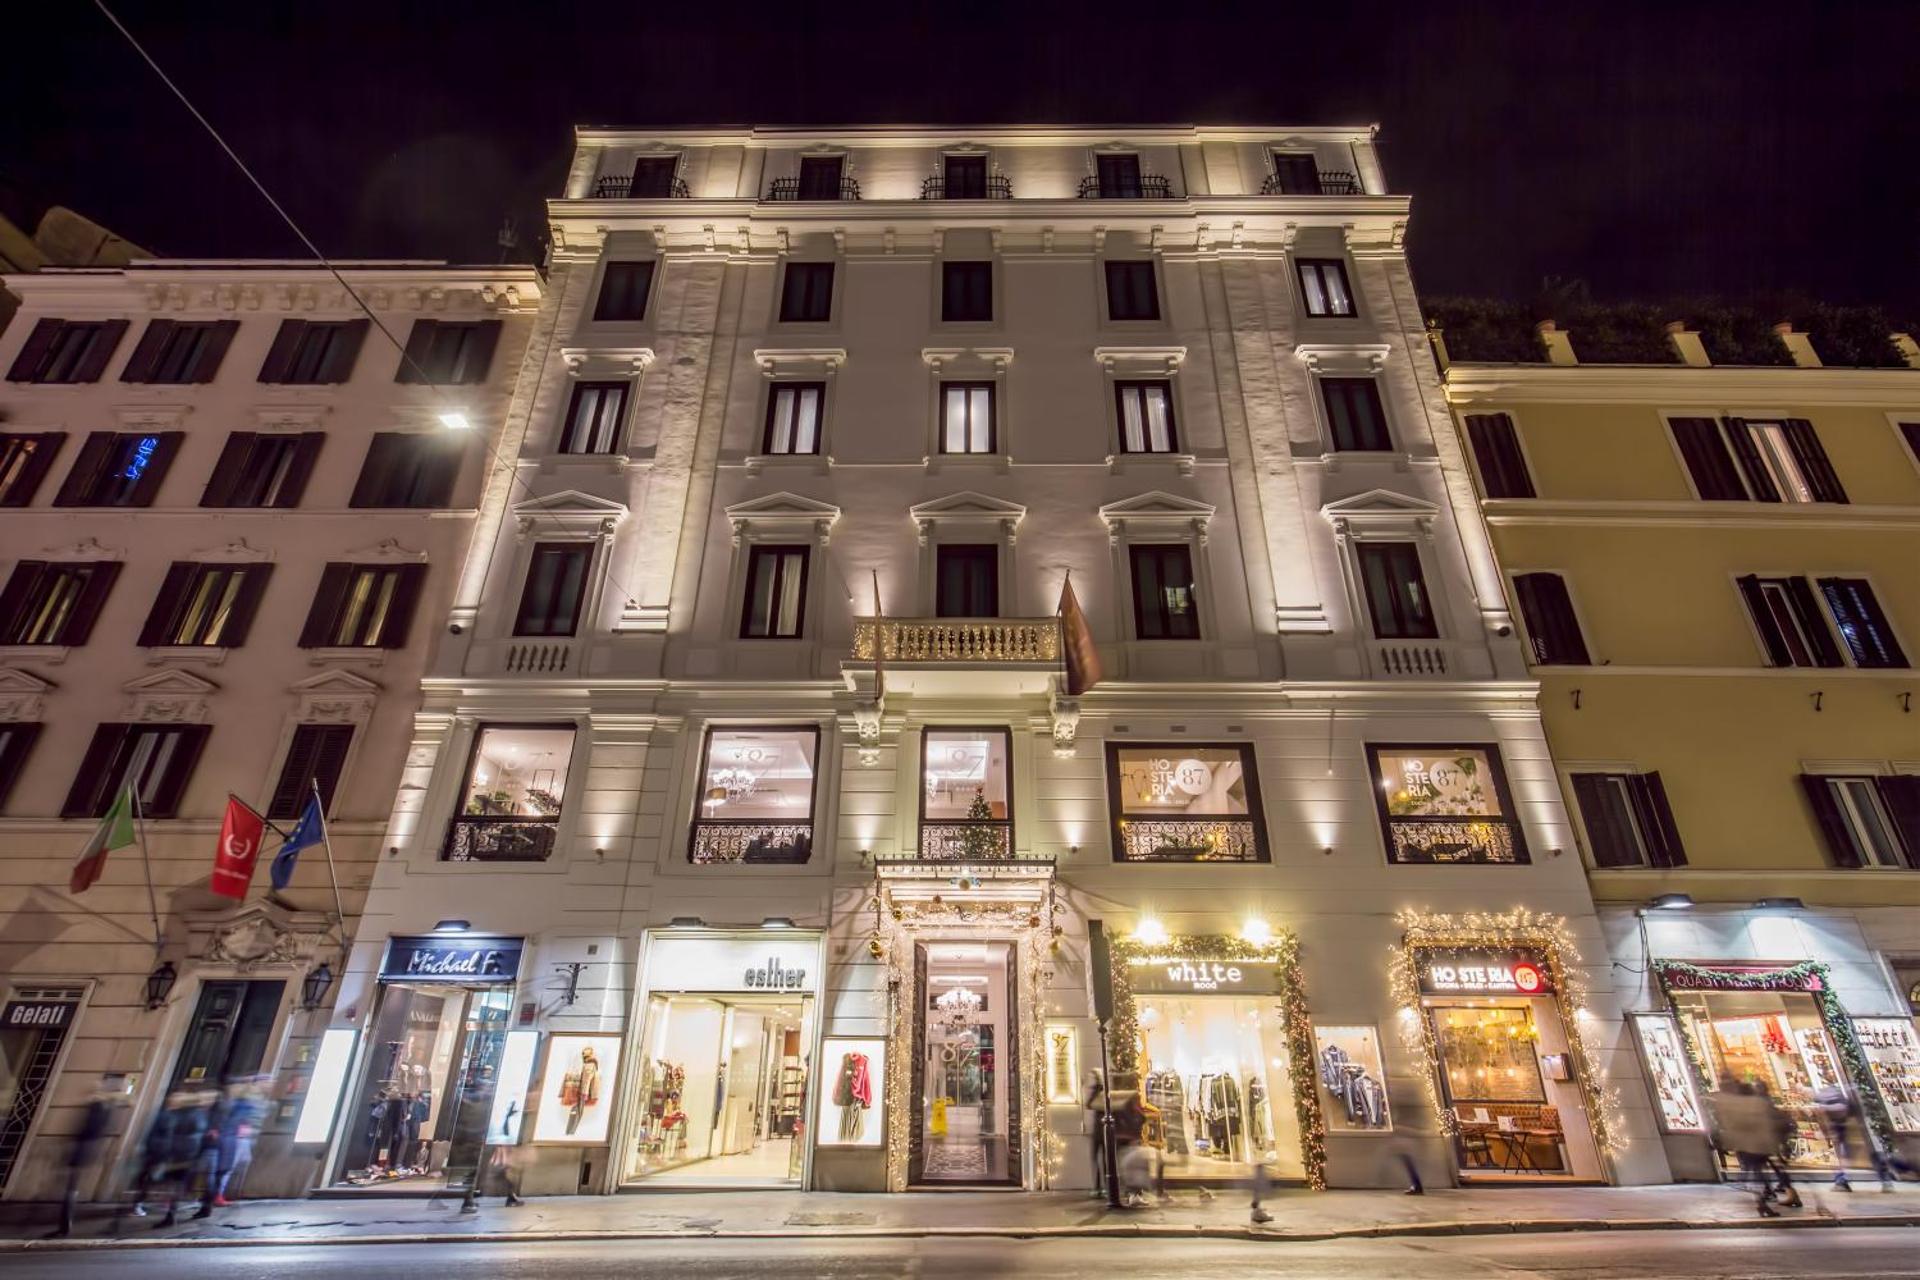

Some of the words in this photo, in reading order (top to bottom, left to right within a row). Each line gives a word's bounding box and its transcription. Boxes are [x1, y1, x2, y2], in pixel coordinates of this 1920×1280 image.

[1151, 771, 1175, 783] STE
[1182, 769, 1204, 785] 87
[1405, 772, 1431, 784] STE
[1437, 769, 1459, 786] 87
[1151, 783, 1175, 796] RIA
[1408, 785, 1432, 797] RIA
[407, 951, 478, 973] Michael
[745, 957, 805, 988] esther
[1167, 962, 1242, 983] white
[1194, 981, 1217, 990] mood
[10, 1005, 66, 1024] Gelati
